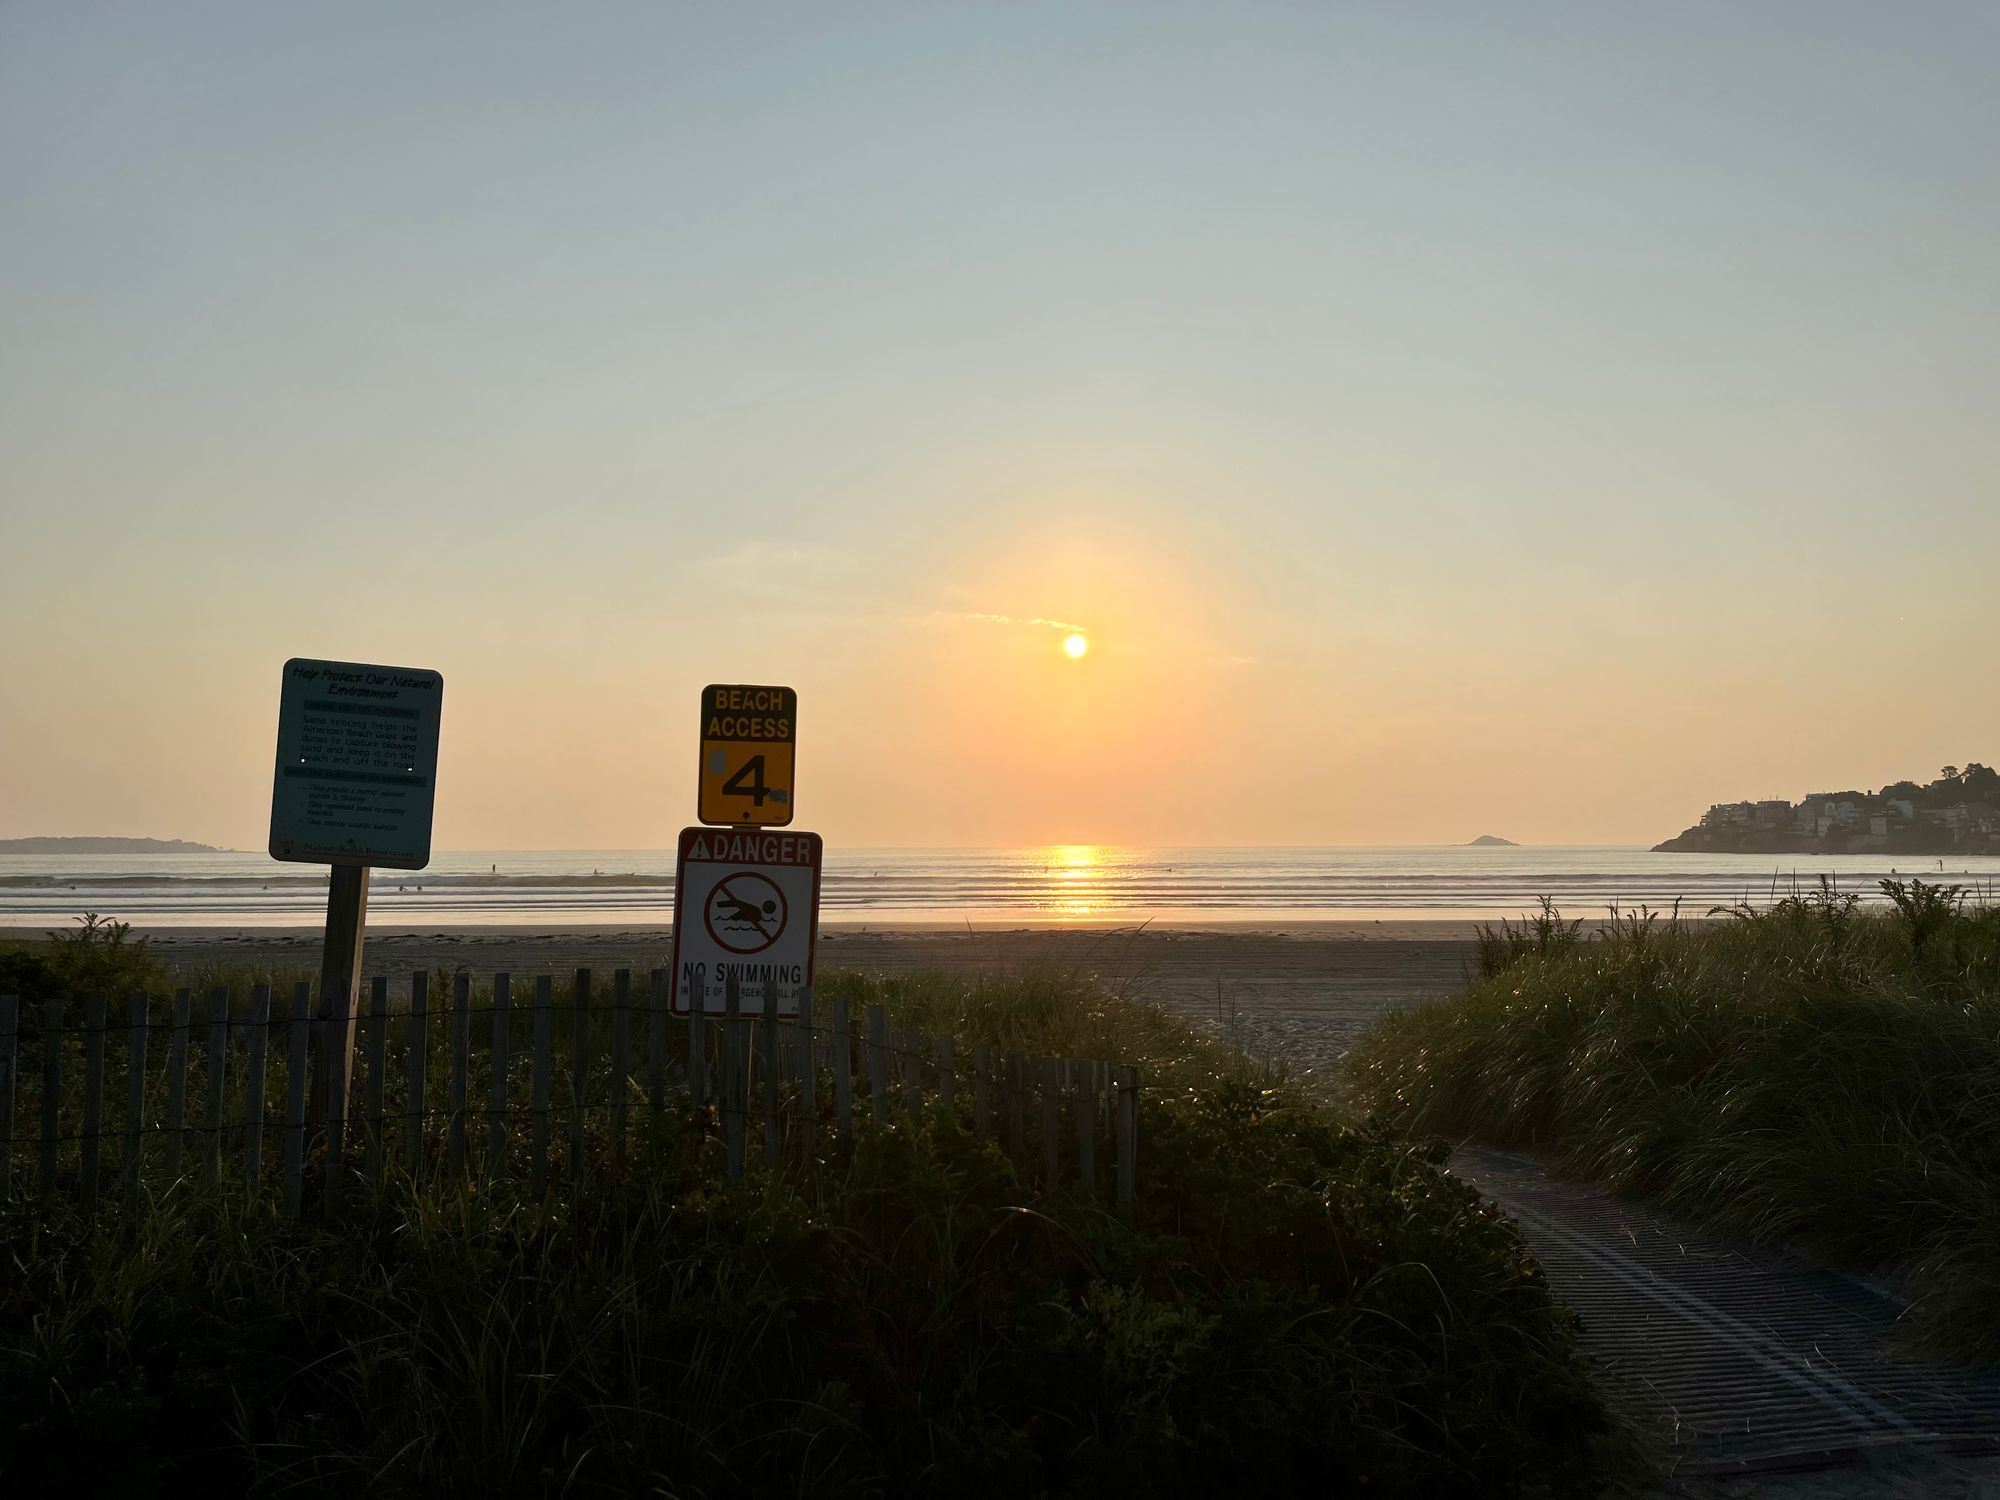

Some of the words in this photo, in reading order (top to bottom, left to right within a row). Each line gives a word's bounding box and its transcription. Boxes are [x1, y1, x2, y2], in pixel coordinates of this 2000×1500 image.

[292, 668, 318, 682] Help
[321, 669, 363, 683] Protect
[366, 673, 389, 685] Our
[390, 676, 435, 690] Natural
[327, 684, 400, 699] Environment
[715, 690, 782, 711] BEACH
[303, 715, 327, 726] Sand
[331, 718, 366, 729] fencing
[371, 721, 397, 732] helps
[401, 724, 417, 732] the
[708, 717, 789, 739] ACCESS
[302, 725, 344, 735] American
[400, 734, 417, 742] and
[331, 737, 342, 745] to
[344, 739, 379, 748] capture
[381, 741, 417, 752] blowing
[326, 746, 343, 754] and
[348, 748, 370, 758] keep
[384, 751, 397, 759] on
[400, 752, 416, 761] the
[332, 756, 350, 764] and
[353, 757, 369, 766] off
[373, 759, 389, 768] the
[722, 755, 771, 807] 4
[713, 834, 811, 864] DANGER
[683, 962, 705, 981] NO
[716, 963, 801, 984] SWIMMING
[713, 986, 724, 997] OF
[776, 989, 788, 998] ALL
